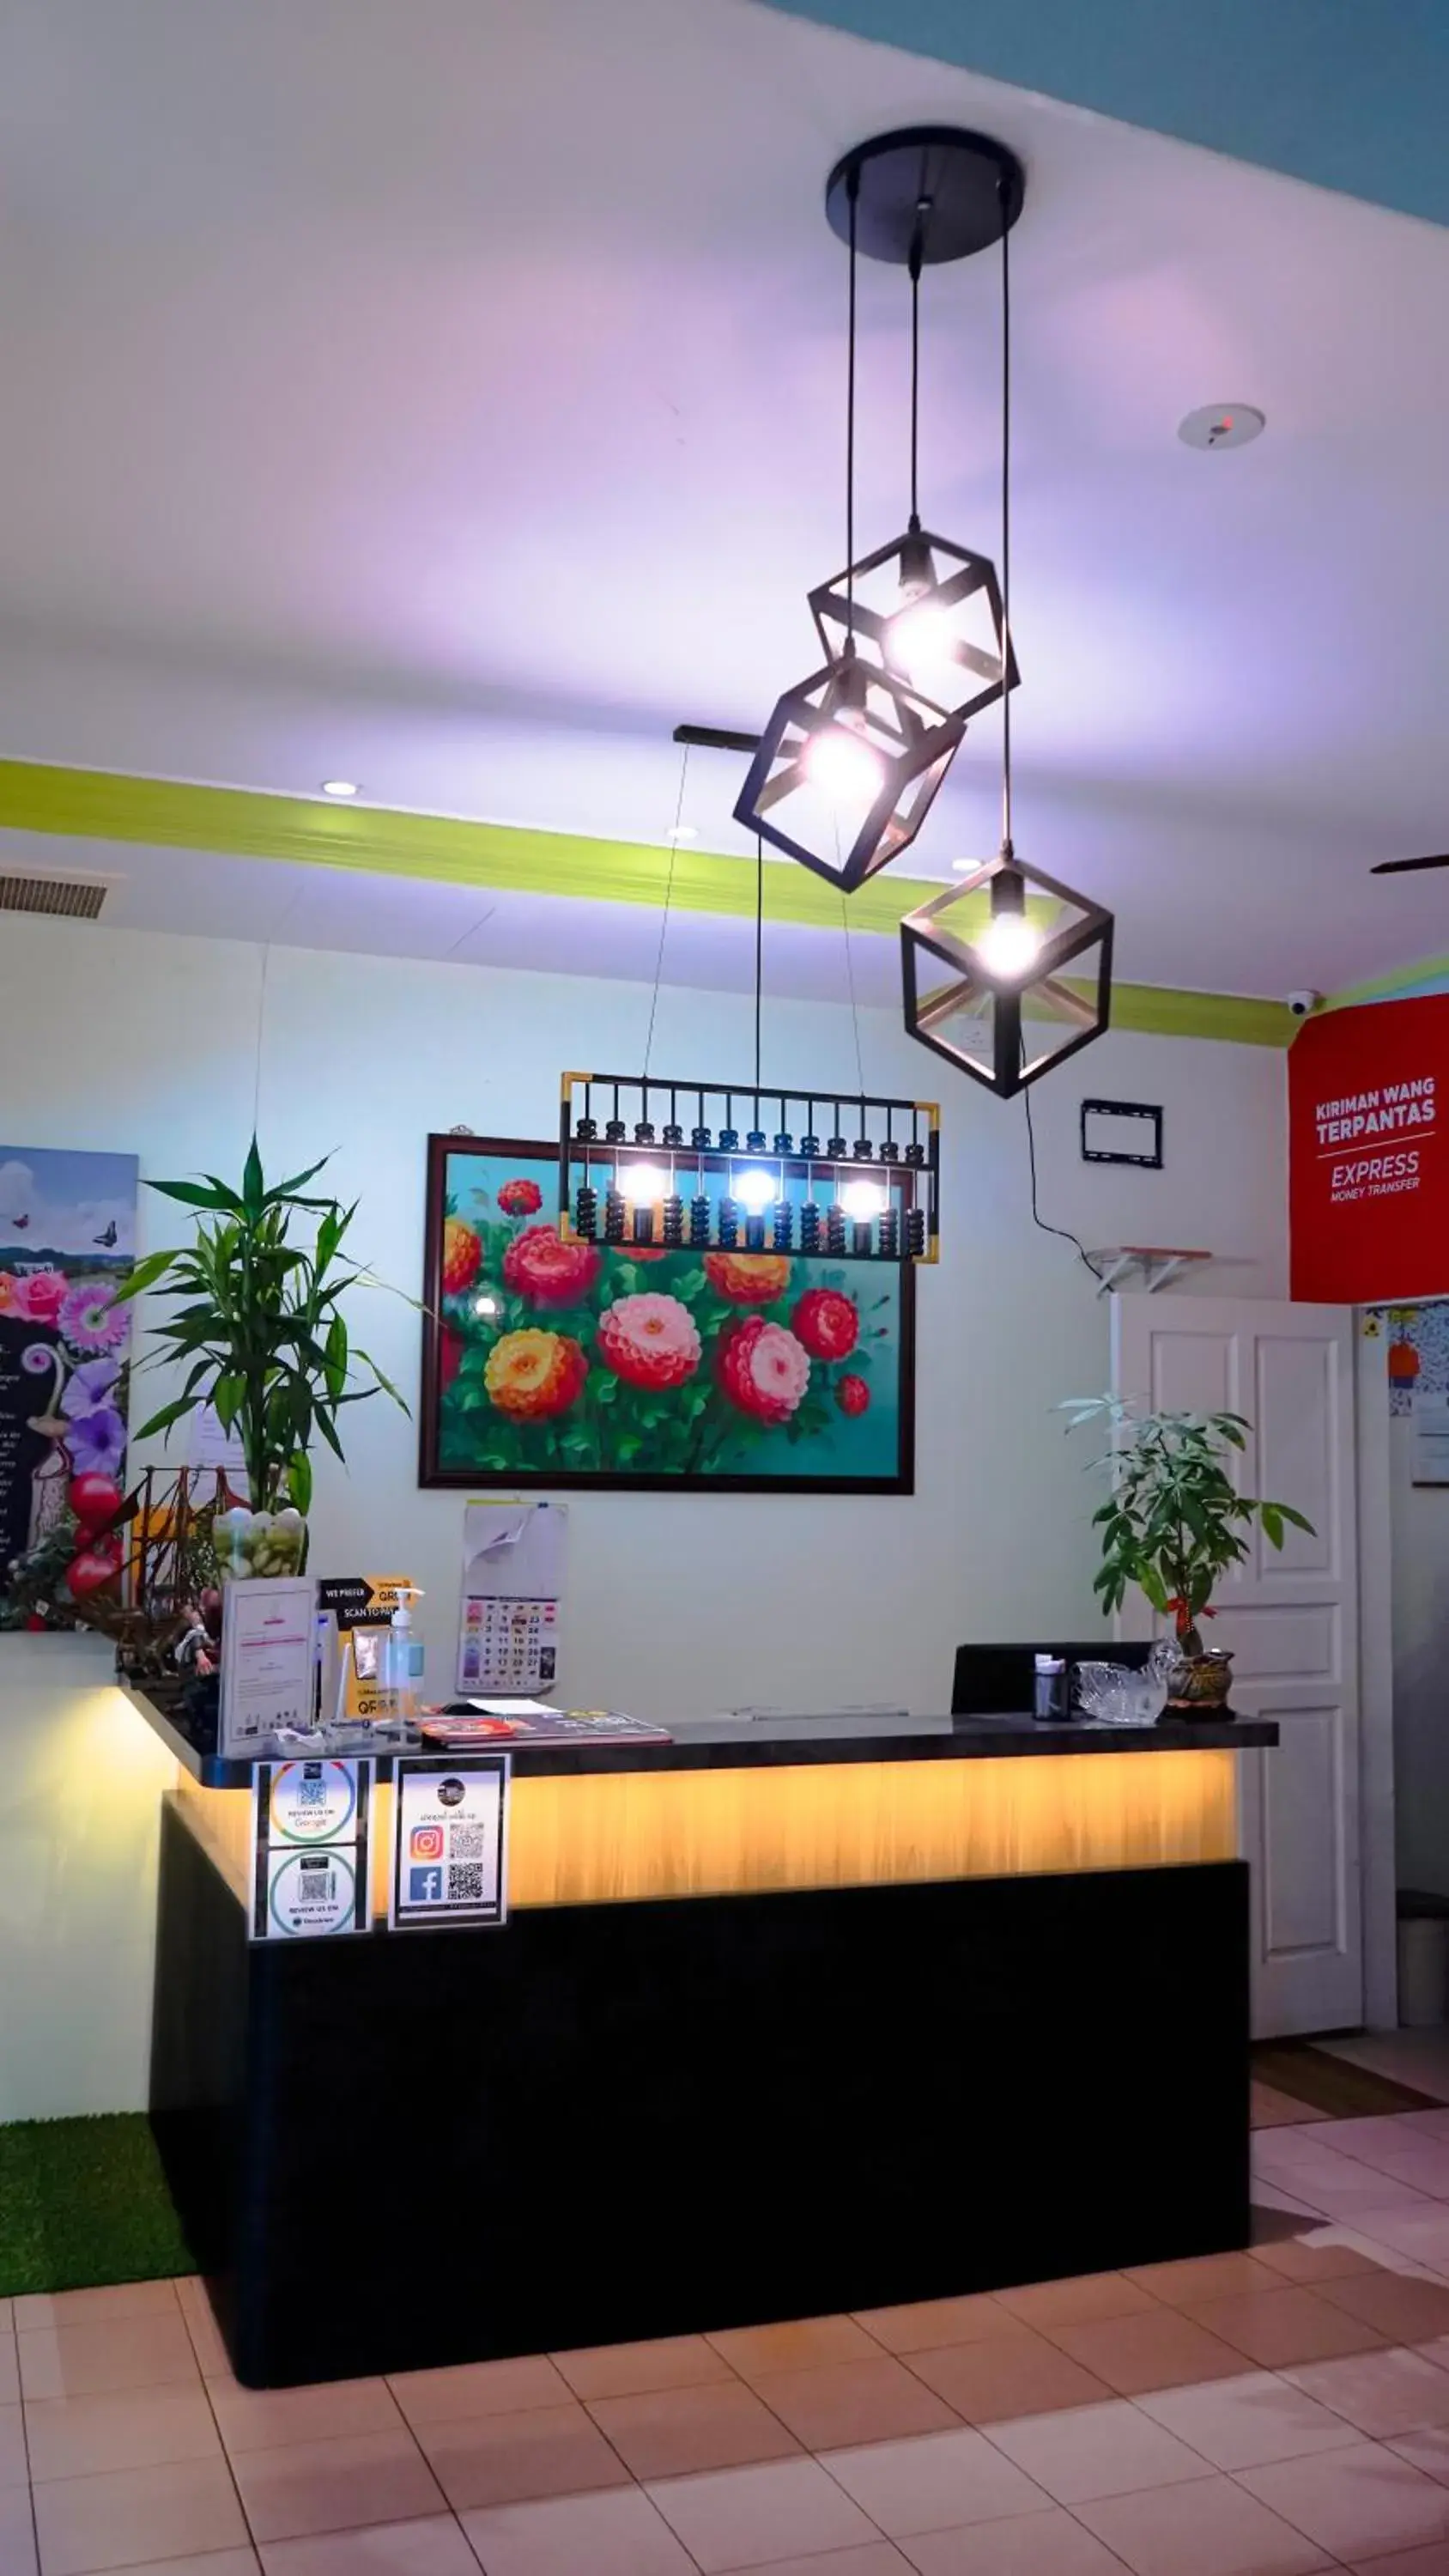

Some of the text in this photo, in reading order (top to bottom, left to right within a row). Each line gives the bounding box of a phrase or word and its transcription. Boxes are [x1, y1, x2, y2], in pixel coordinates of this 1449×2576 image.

[1316, 1078, 1435, 1121] KIRIMAN WANG
[1316, 1099, 1436, 1145] TERPANTAS
[1331, 1151, 1420, 1188] EXPRESS
[1331, 1177, 1421, 1202] MONEY TRANSFER
[326, 1587, 365, 1598] WE PREFER
[344, 1607, 367, 1618] SCAN
